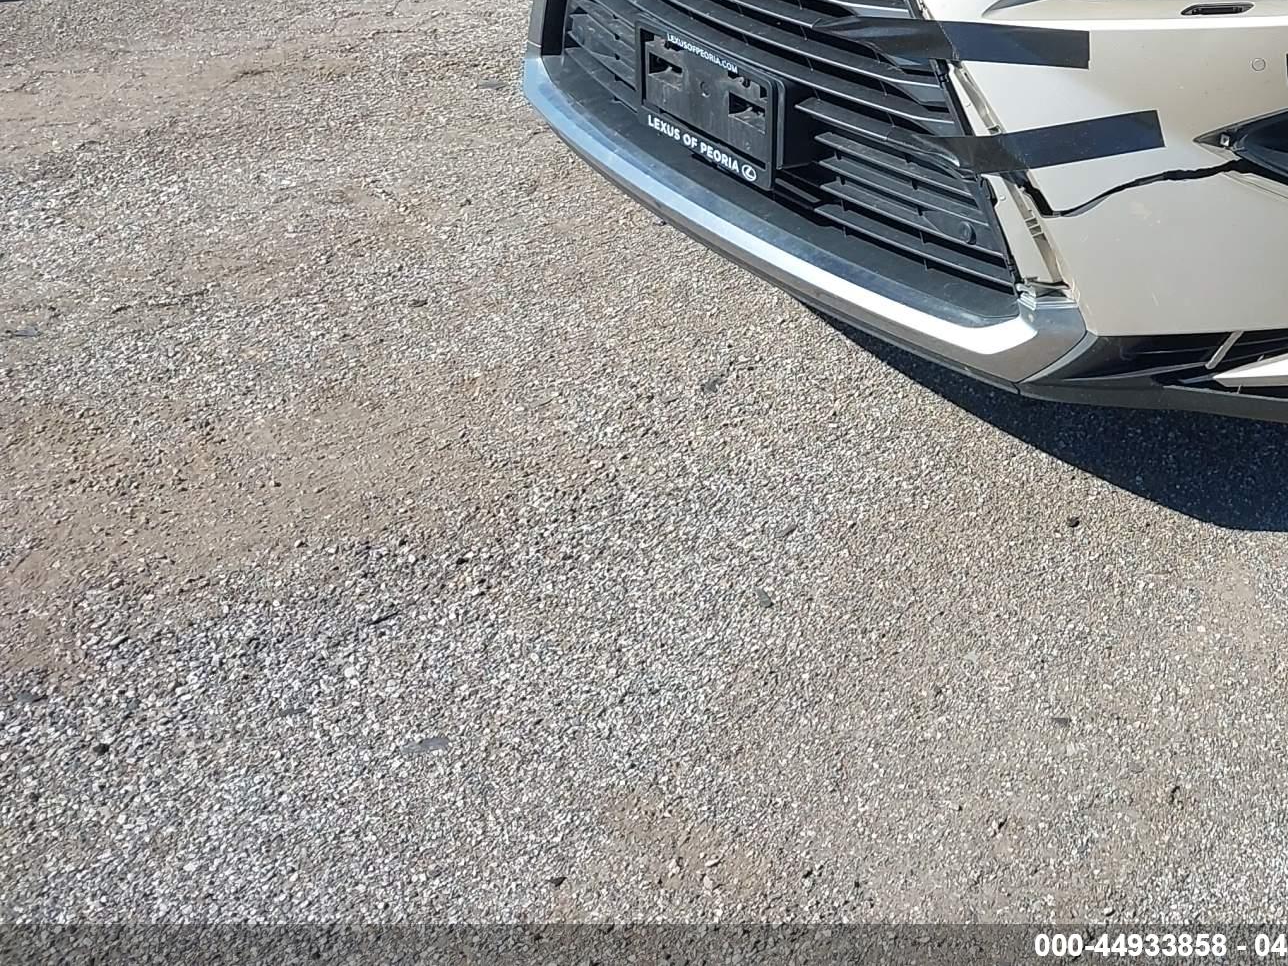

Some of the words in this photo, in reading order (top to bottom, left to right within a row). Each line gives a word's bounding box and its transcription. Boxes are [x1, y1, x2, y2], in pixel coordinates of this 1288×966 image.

[667, 33, 738, 74] LEXUSOFPEORIA.COM
[648, 114, 681, 140] LEXUS
[683, 134, 698, 149] OF
[700, 142, 739, 173] PEORIA
